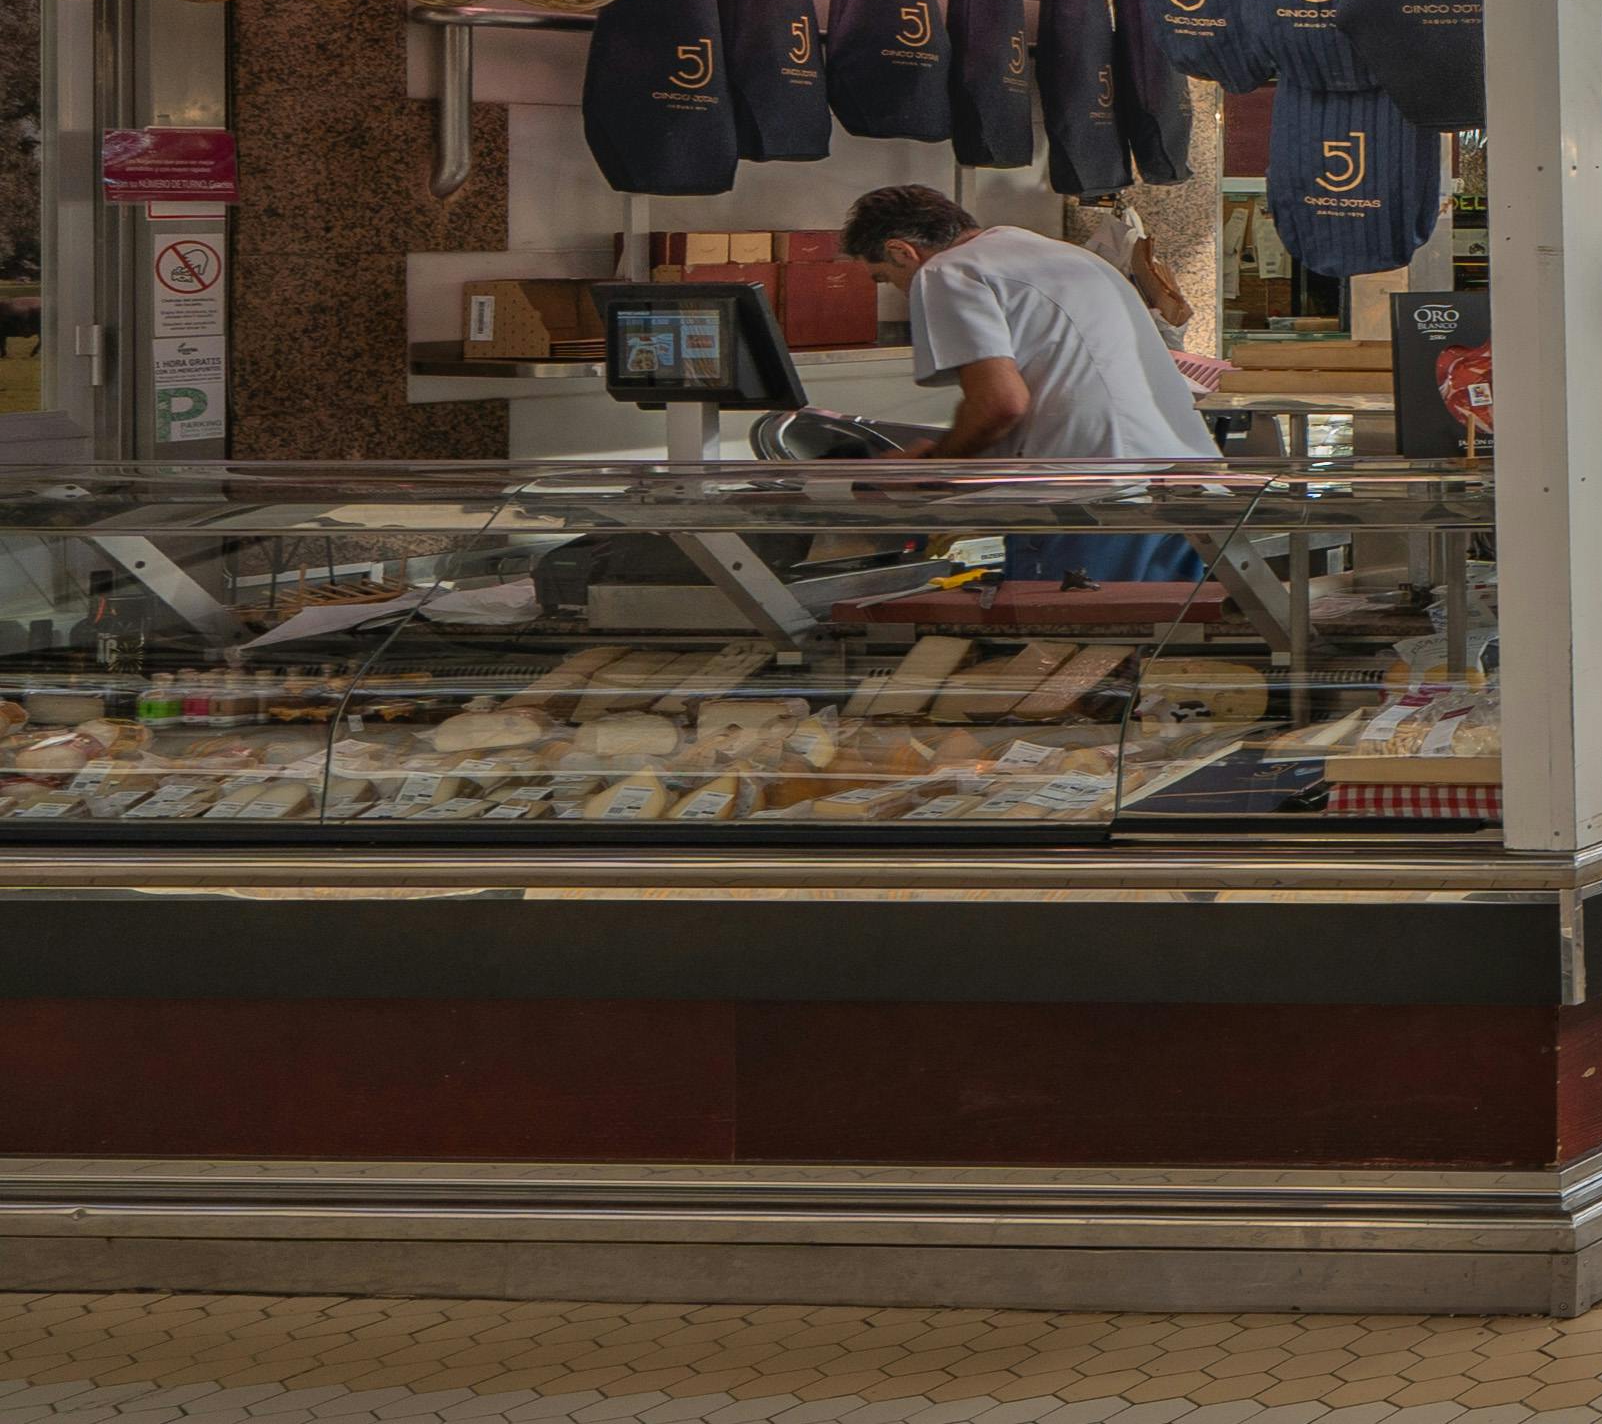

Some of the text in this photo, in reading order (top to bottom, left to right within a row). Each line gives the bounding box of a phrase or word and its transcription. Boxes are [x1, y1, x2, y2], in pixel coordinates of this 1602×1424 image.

[1276, 8, 1317, 19] CINCO
[1401, 4, 1485, 15] CINCO JOTA
[896, 1, 931, 47] 5J
[789, 15, 810, 63] 5J
[669, 38, 712, 88] 5J
[1315, 131, 1365, 192] 5J
[1303, 195, 1382, 209] CINCO JOTAS
[1413, 308, 1460, 323] ORO
[1416, 322, 1458, 330] BLANCO
